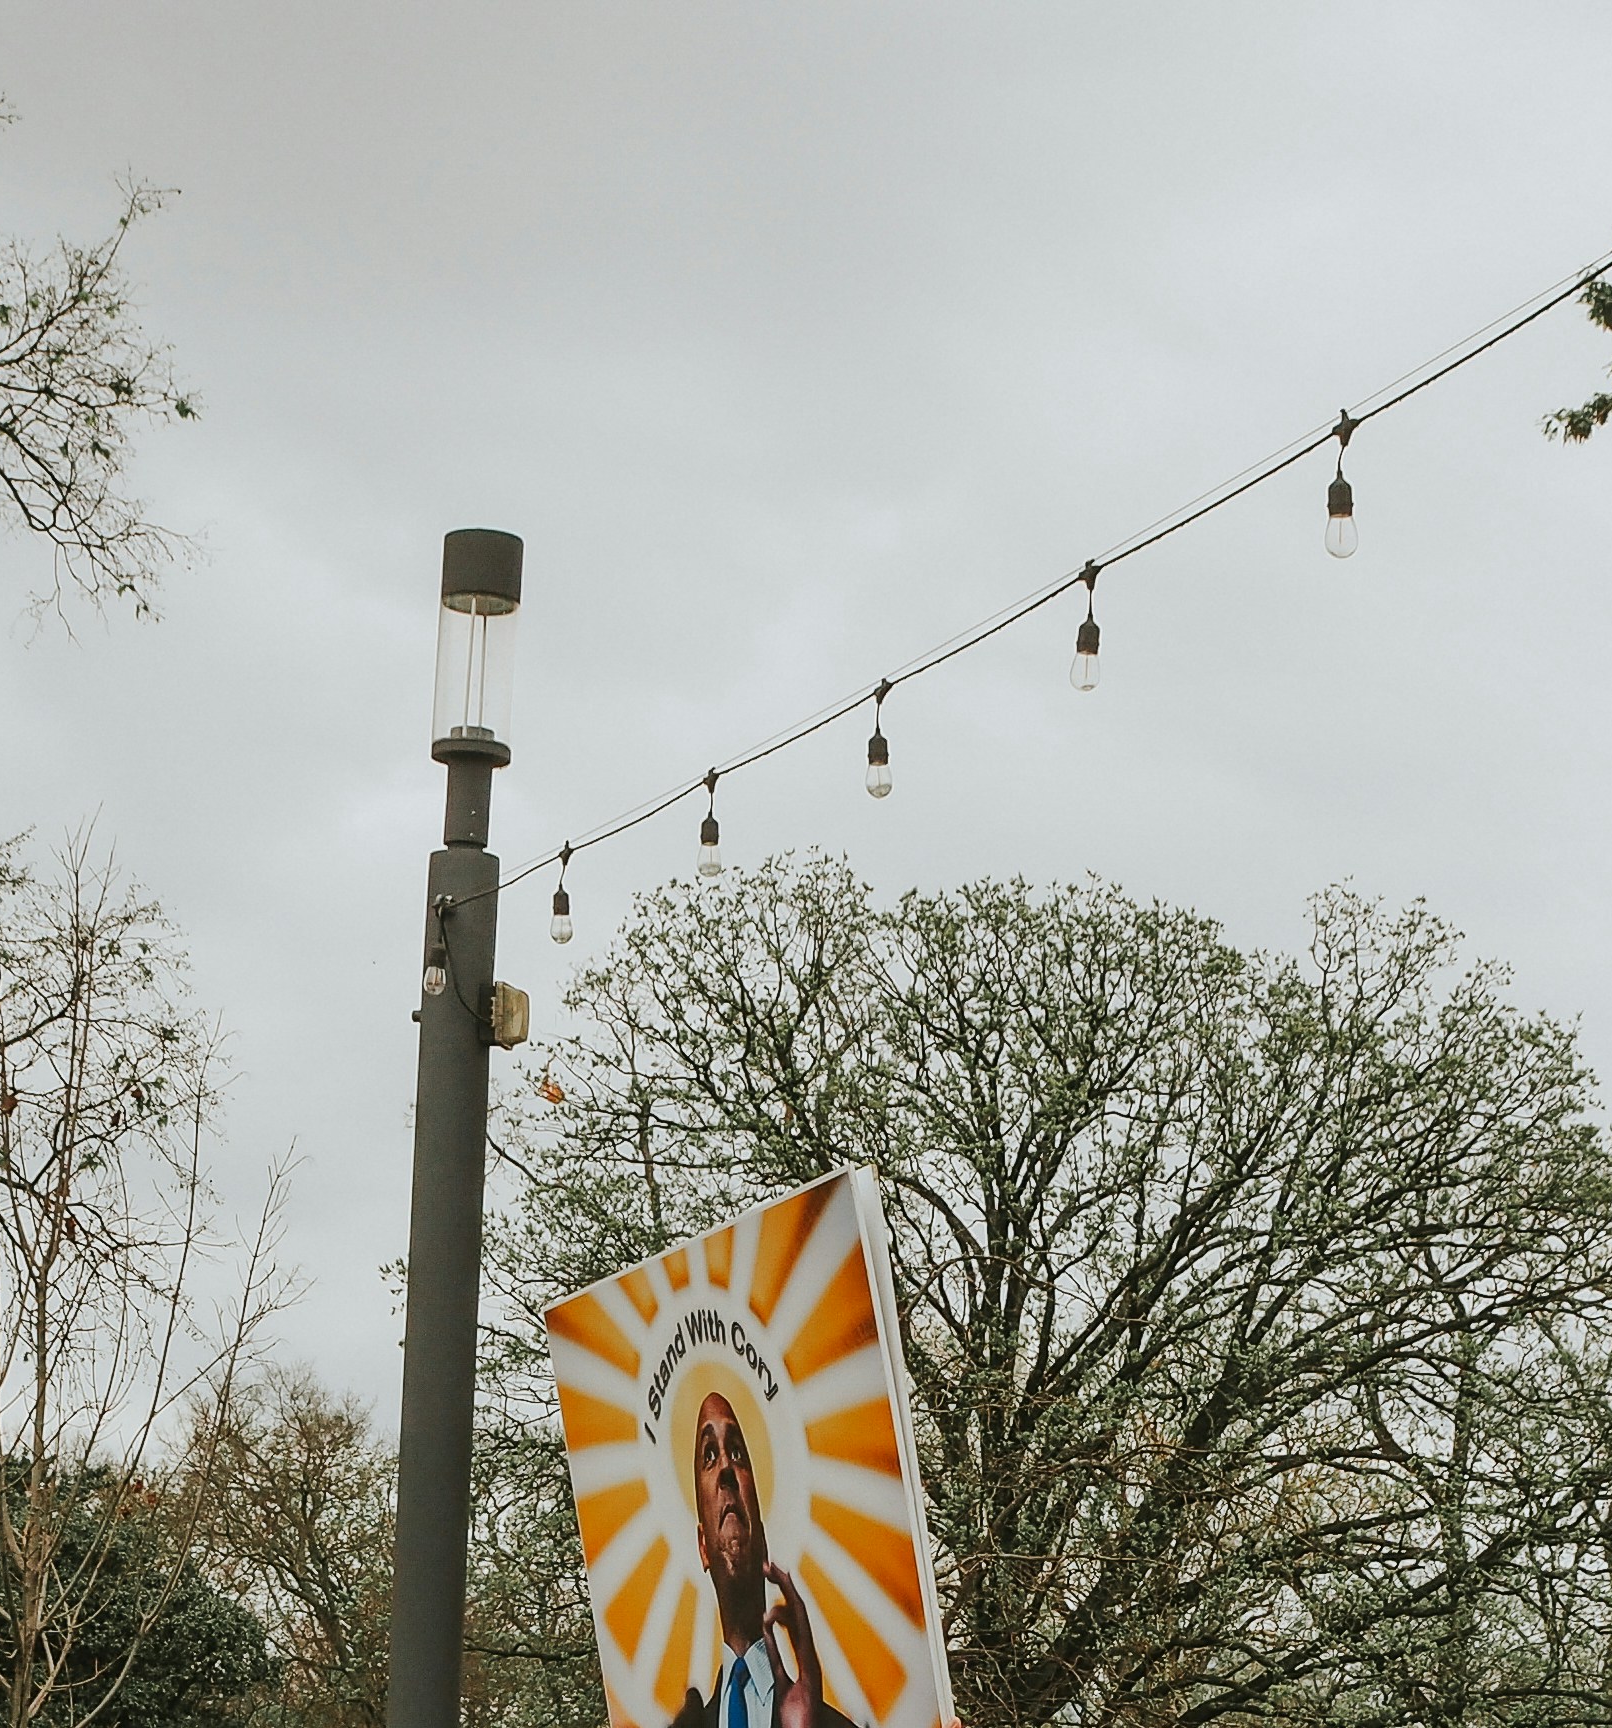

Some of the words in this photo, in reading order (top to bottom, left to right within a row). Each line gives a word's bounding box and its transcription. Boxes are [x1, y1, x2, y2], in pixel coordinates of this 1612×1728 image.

[685, 1309, 727, 1347] With
[648, 1322, 687, 1421] Stand
[731, 1321, 779, 1401] Cory
[644, 1421, 657, 1445] I
